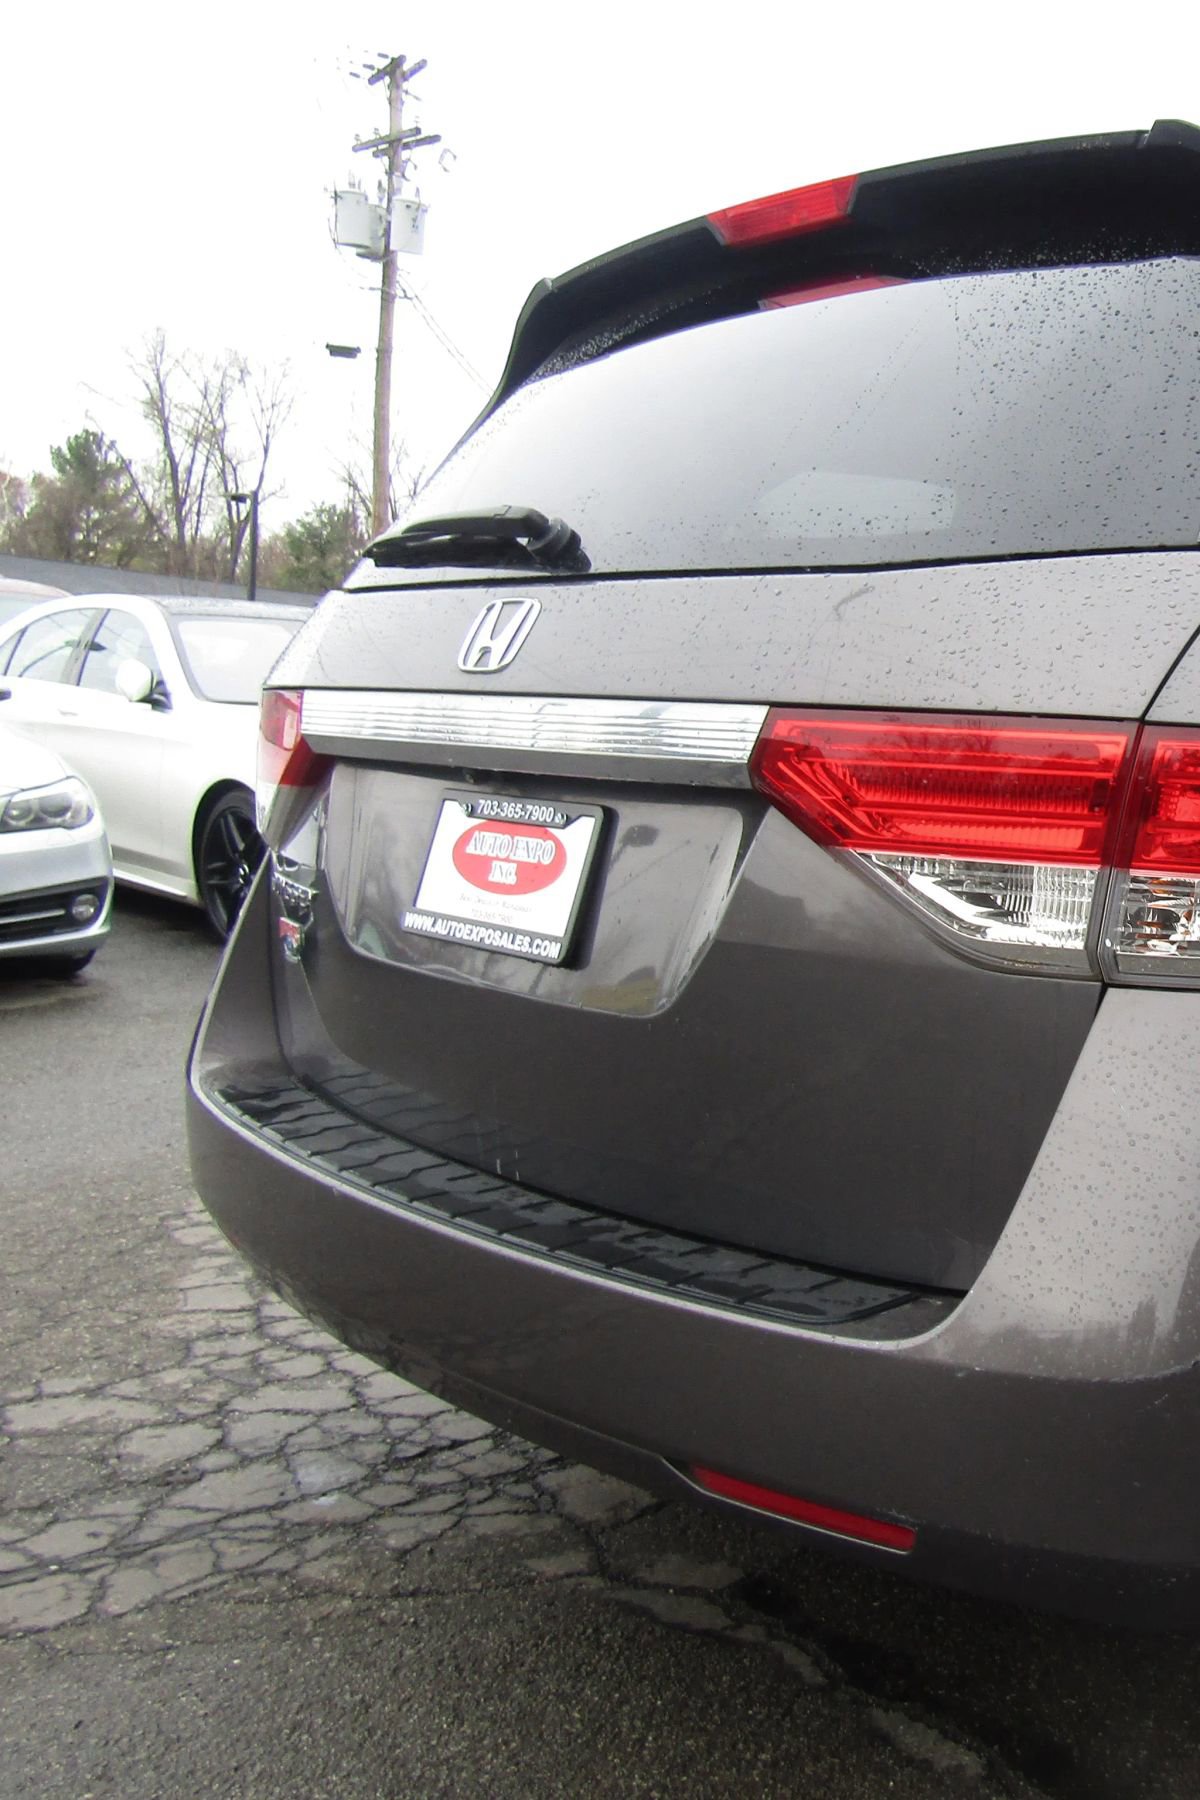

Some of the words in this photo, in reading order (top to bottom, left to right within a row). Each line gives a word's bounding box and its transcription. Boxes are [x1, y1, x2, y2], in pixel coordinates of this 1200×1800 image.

[477, 799, 554, 822] 703-365-7900
[466, 831, 512, 857] AUTO
[510, 836, 555, 864] EXPO
[403, 911, 561, 959] WWW.AUTOEXPOSALES.COM
